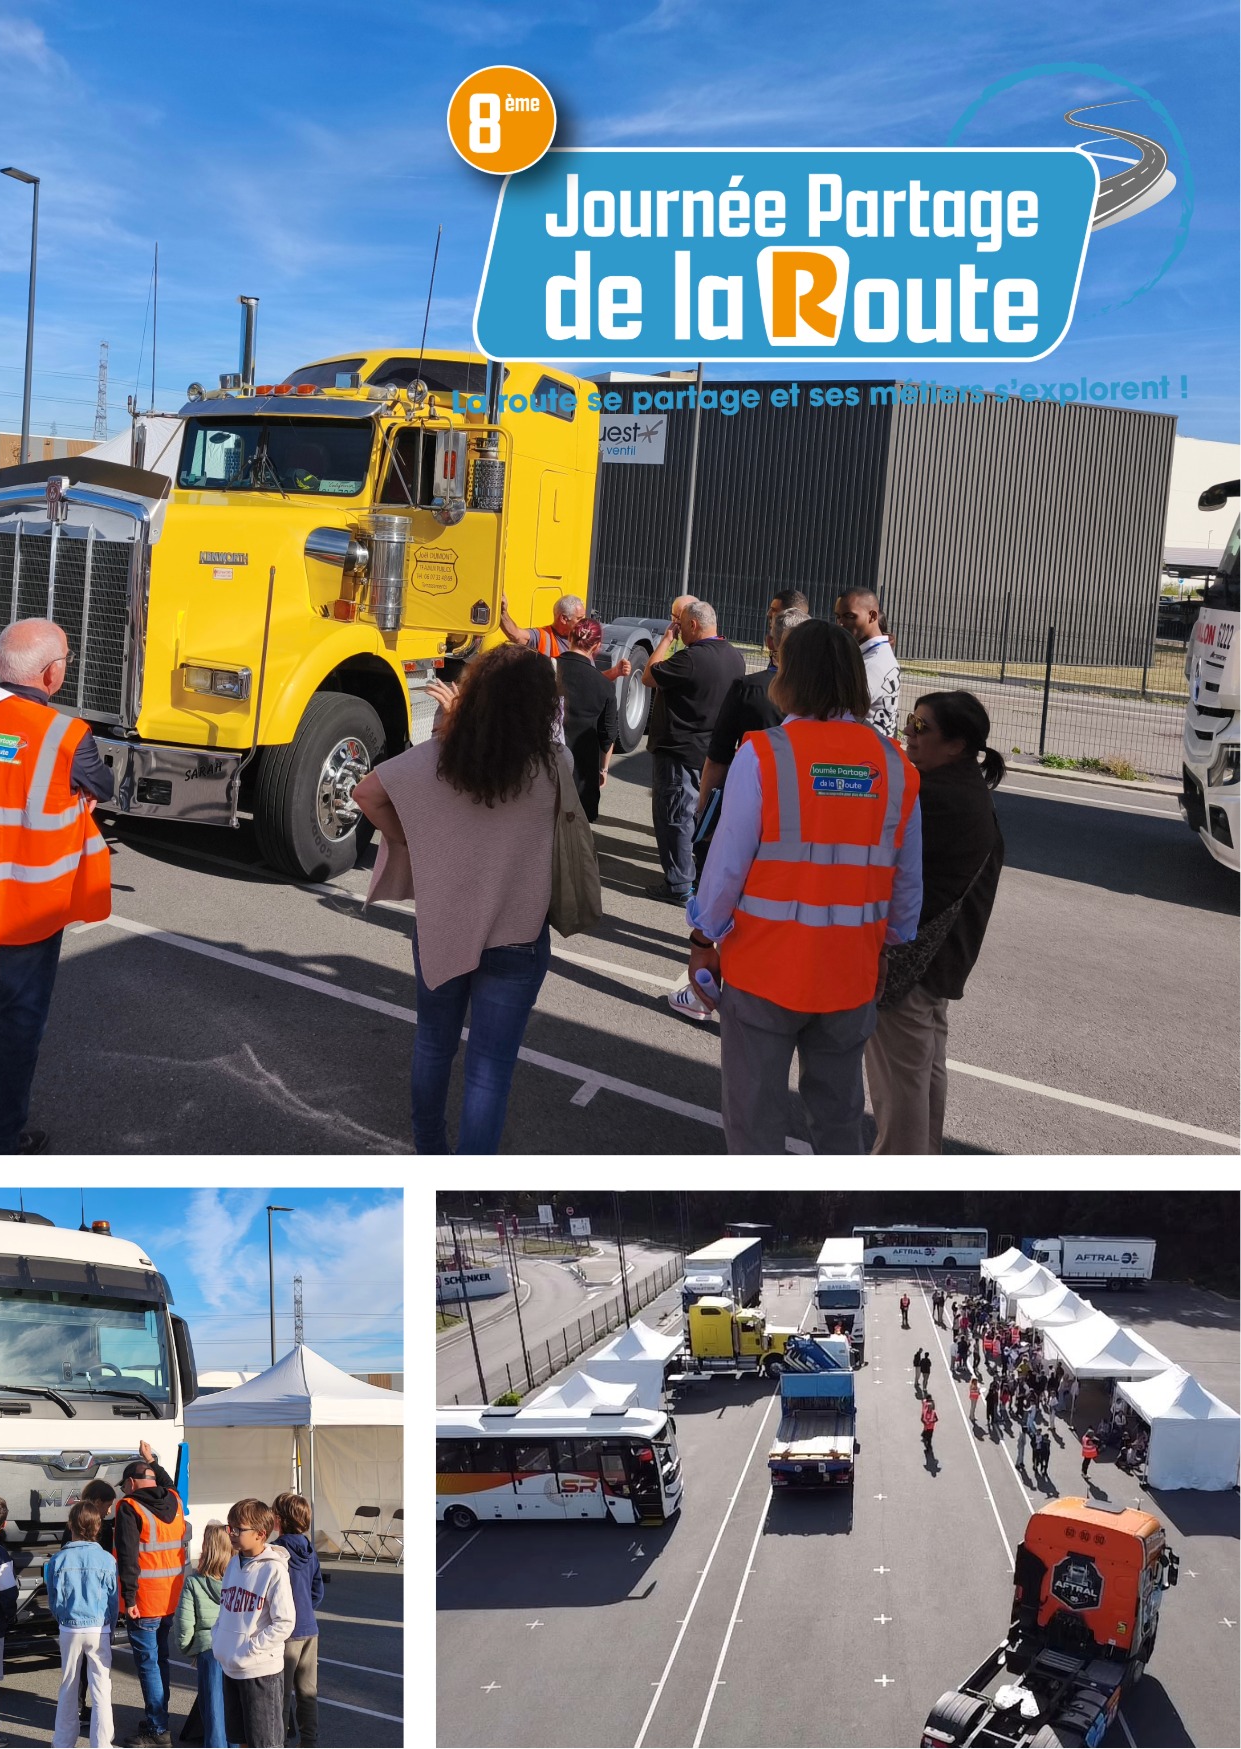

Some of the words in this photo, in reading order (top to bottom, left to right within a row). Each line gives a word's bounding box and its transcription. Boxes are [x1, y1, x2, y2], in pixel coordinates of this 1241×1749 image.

[599, 422, 641, 442] uest
[606, 445, 637, 456] ventil
[199, 551, 248, 565] KENWORTH
[1217, 623, 1234, 650] 6222
[184, 761, 223, 782] SARAH
[812, 766, 837, 775] Journée
[837, 768, 868, 777] Partage
[836, 779, 863, 789] Route
[1074, 1253, 1120, 1262] AFTRAL
[444, 1273, 491, 1285] SCHENKER
[560, 1479, 597, 1493] SR
[40, 1489, 82, 1507] MA
[1054, 1580, 1098, 1598] AFTRAL
[234, 1587, 258, 1613] GIVE
